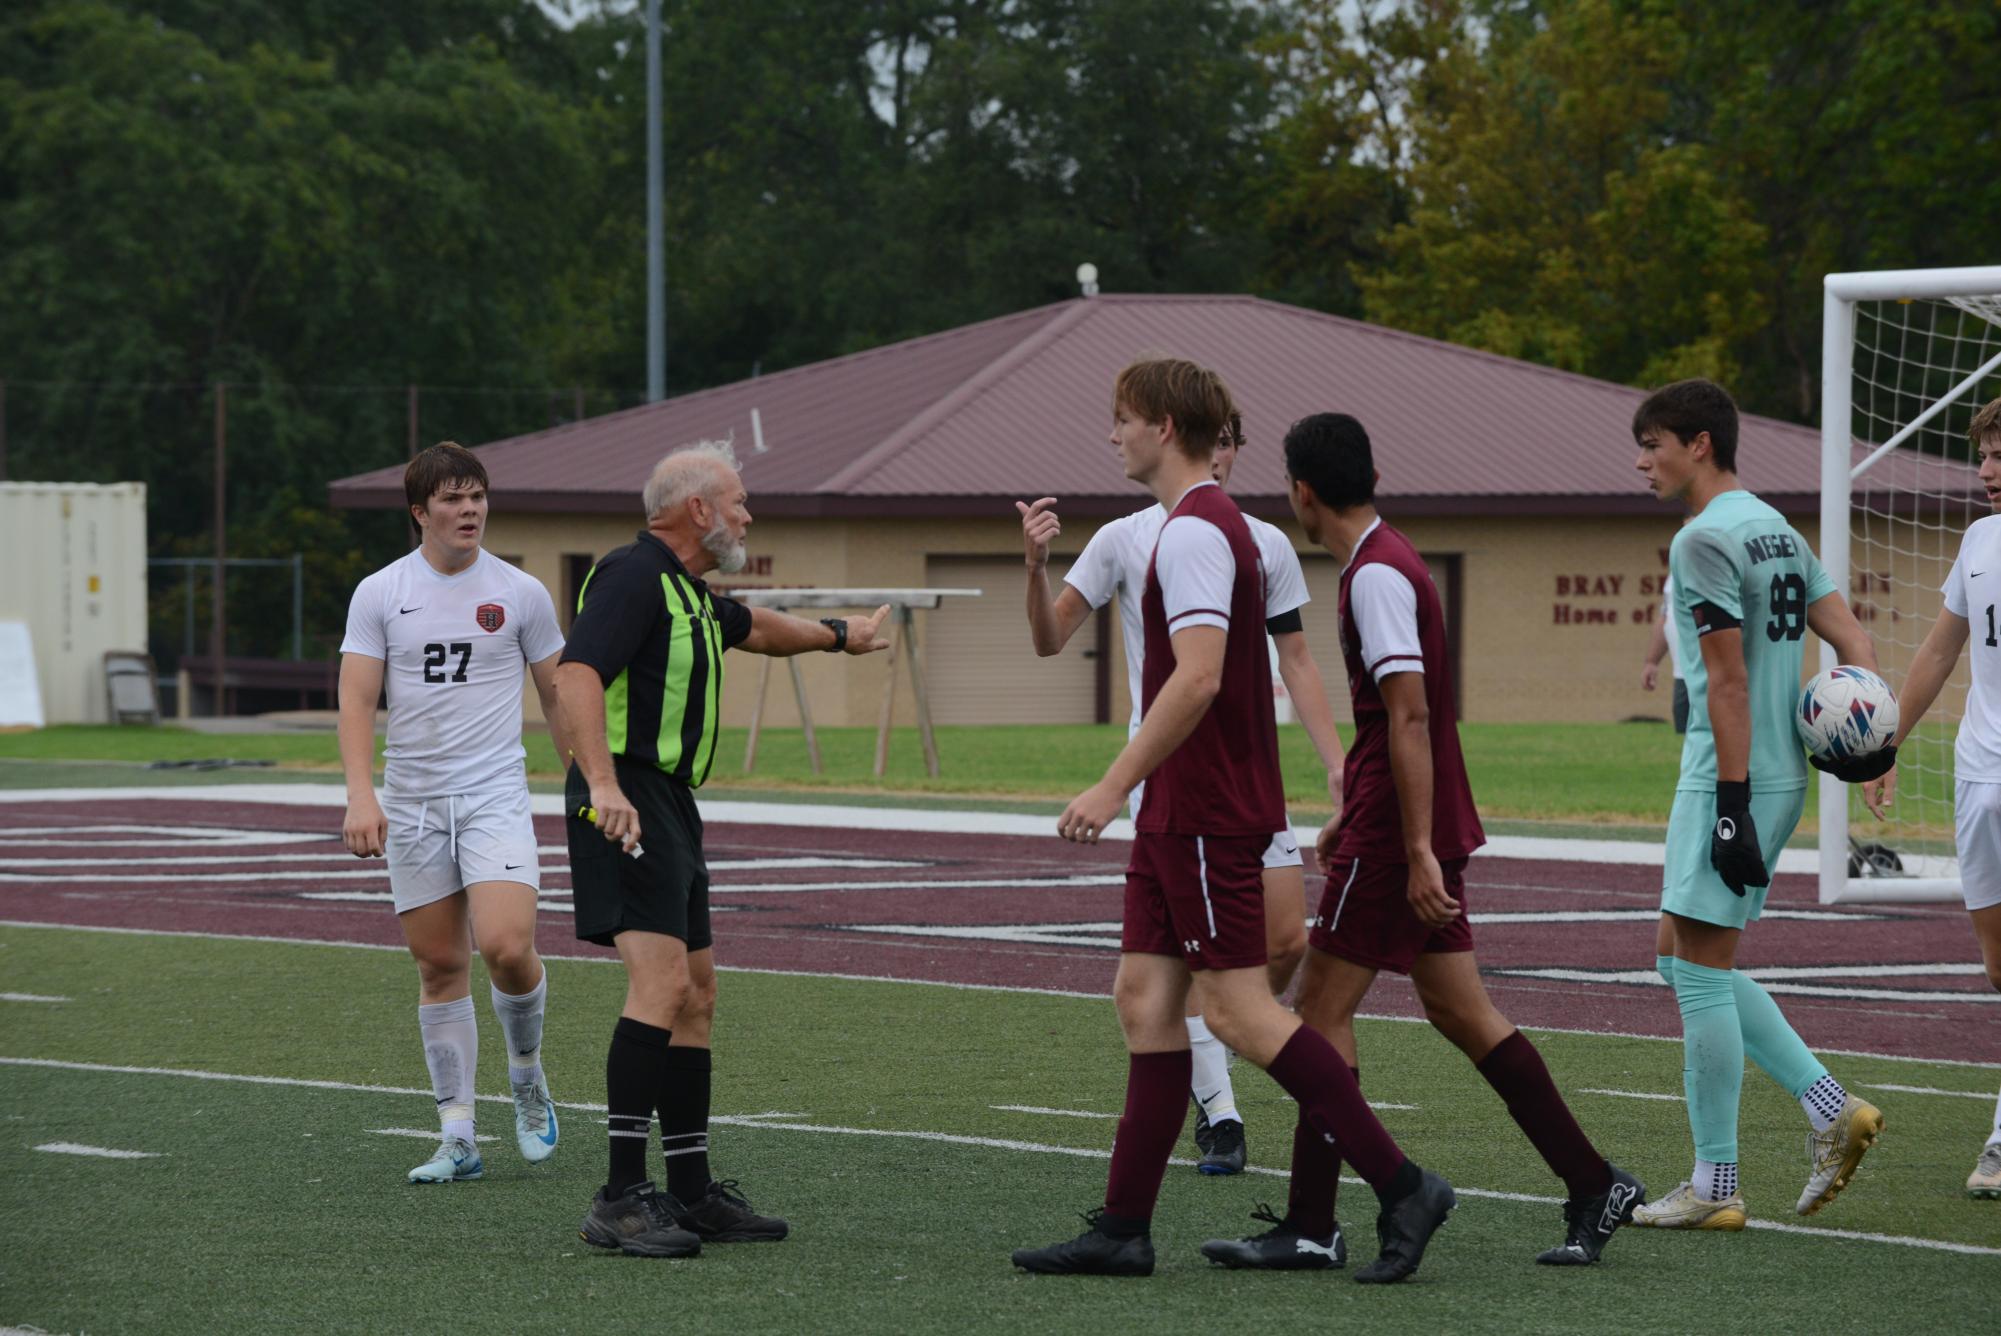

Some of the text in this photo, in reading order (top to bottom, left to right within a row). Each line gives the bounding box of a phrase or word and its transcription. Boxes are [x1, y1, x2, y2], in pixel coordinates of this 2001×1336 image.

[1556, 574, 1624, 596] BRAY
[1553, 604, 1655, 625] Home of
[1766, 573, 1807, 643] 99
[1985, 604, 2001, 648] 1
[424, 643, 472, 683] 27
